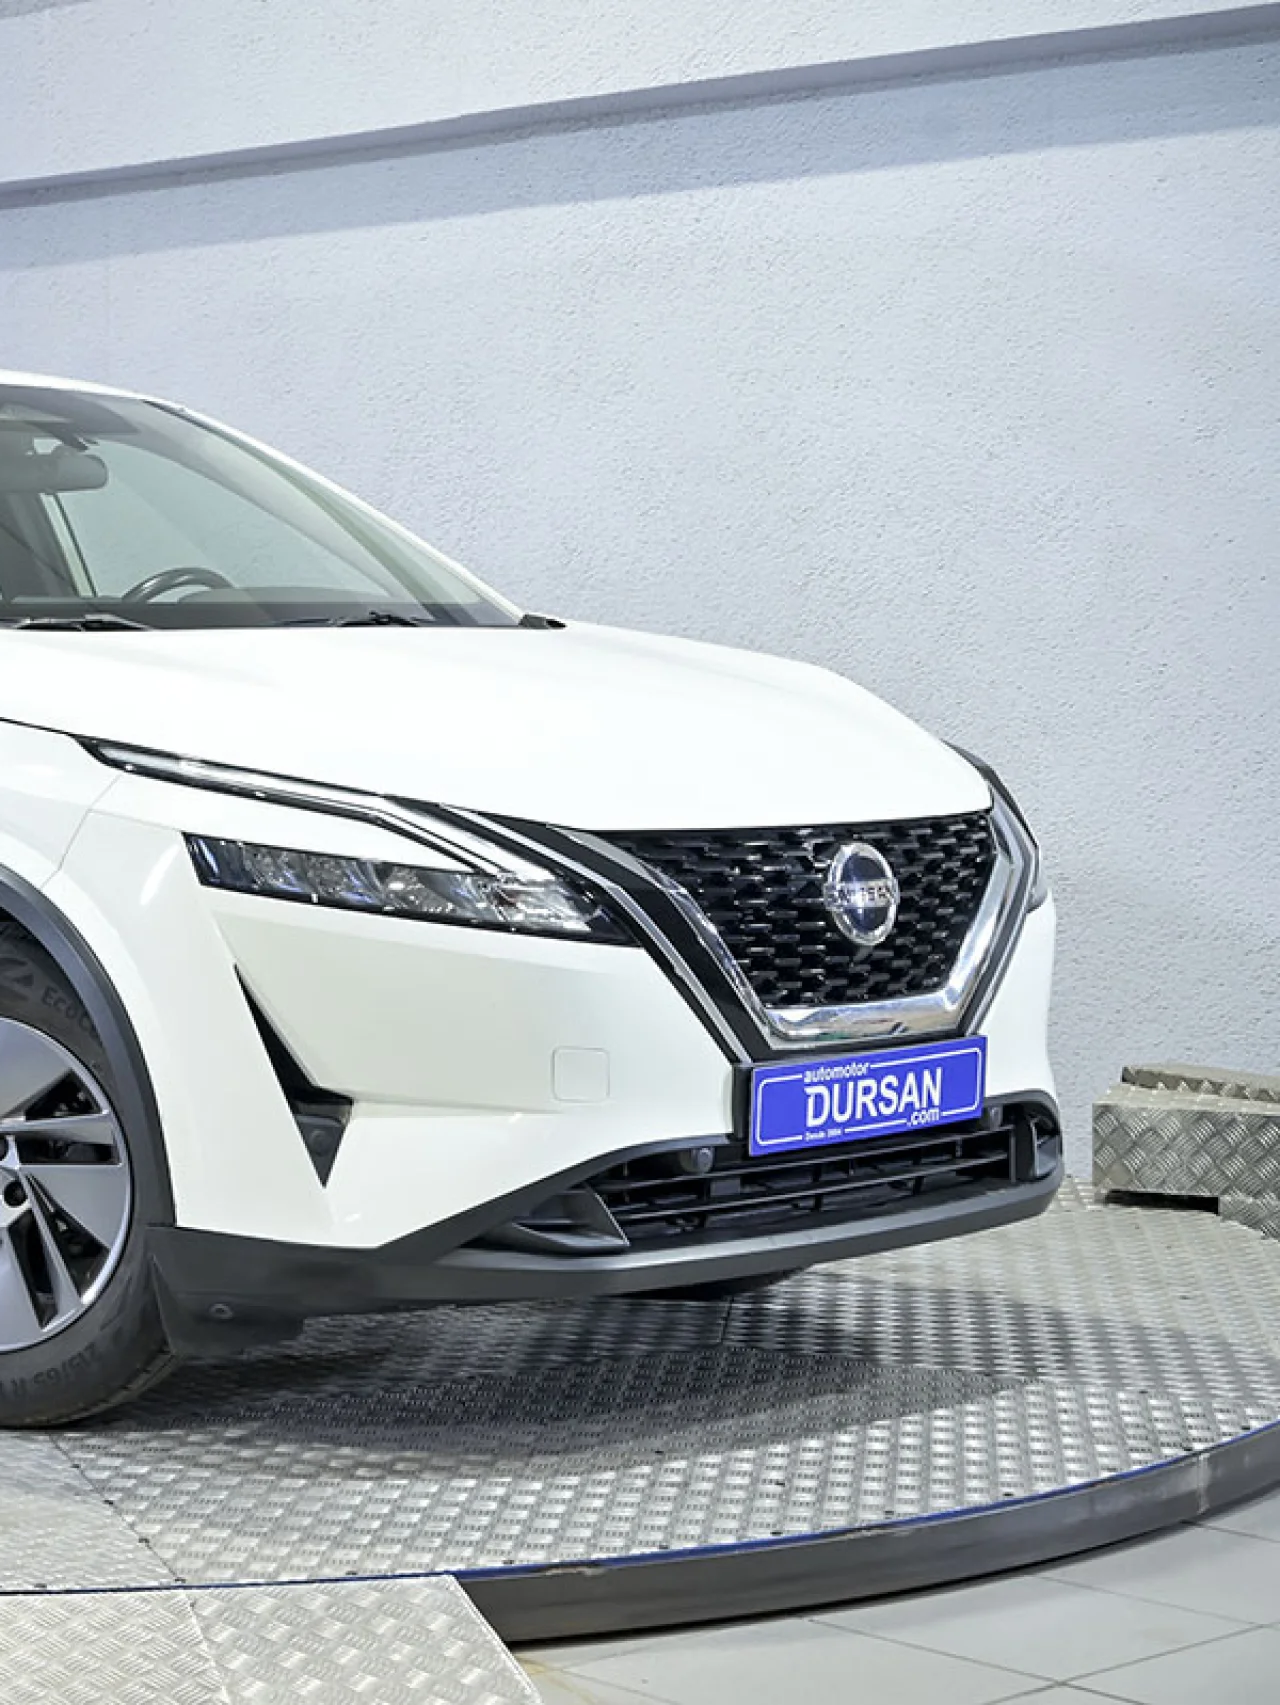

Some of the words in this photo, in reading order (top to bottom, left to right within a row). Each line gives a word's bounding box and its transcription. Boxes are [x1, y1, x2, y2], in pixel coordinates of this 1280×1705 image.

[803, 1062, 870, 1083] automotor
[803, 1067, 943, 1127] DURSAN
[907, 1107, 940, 1127] .com
